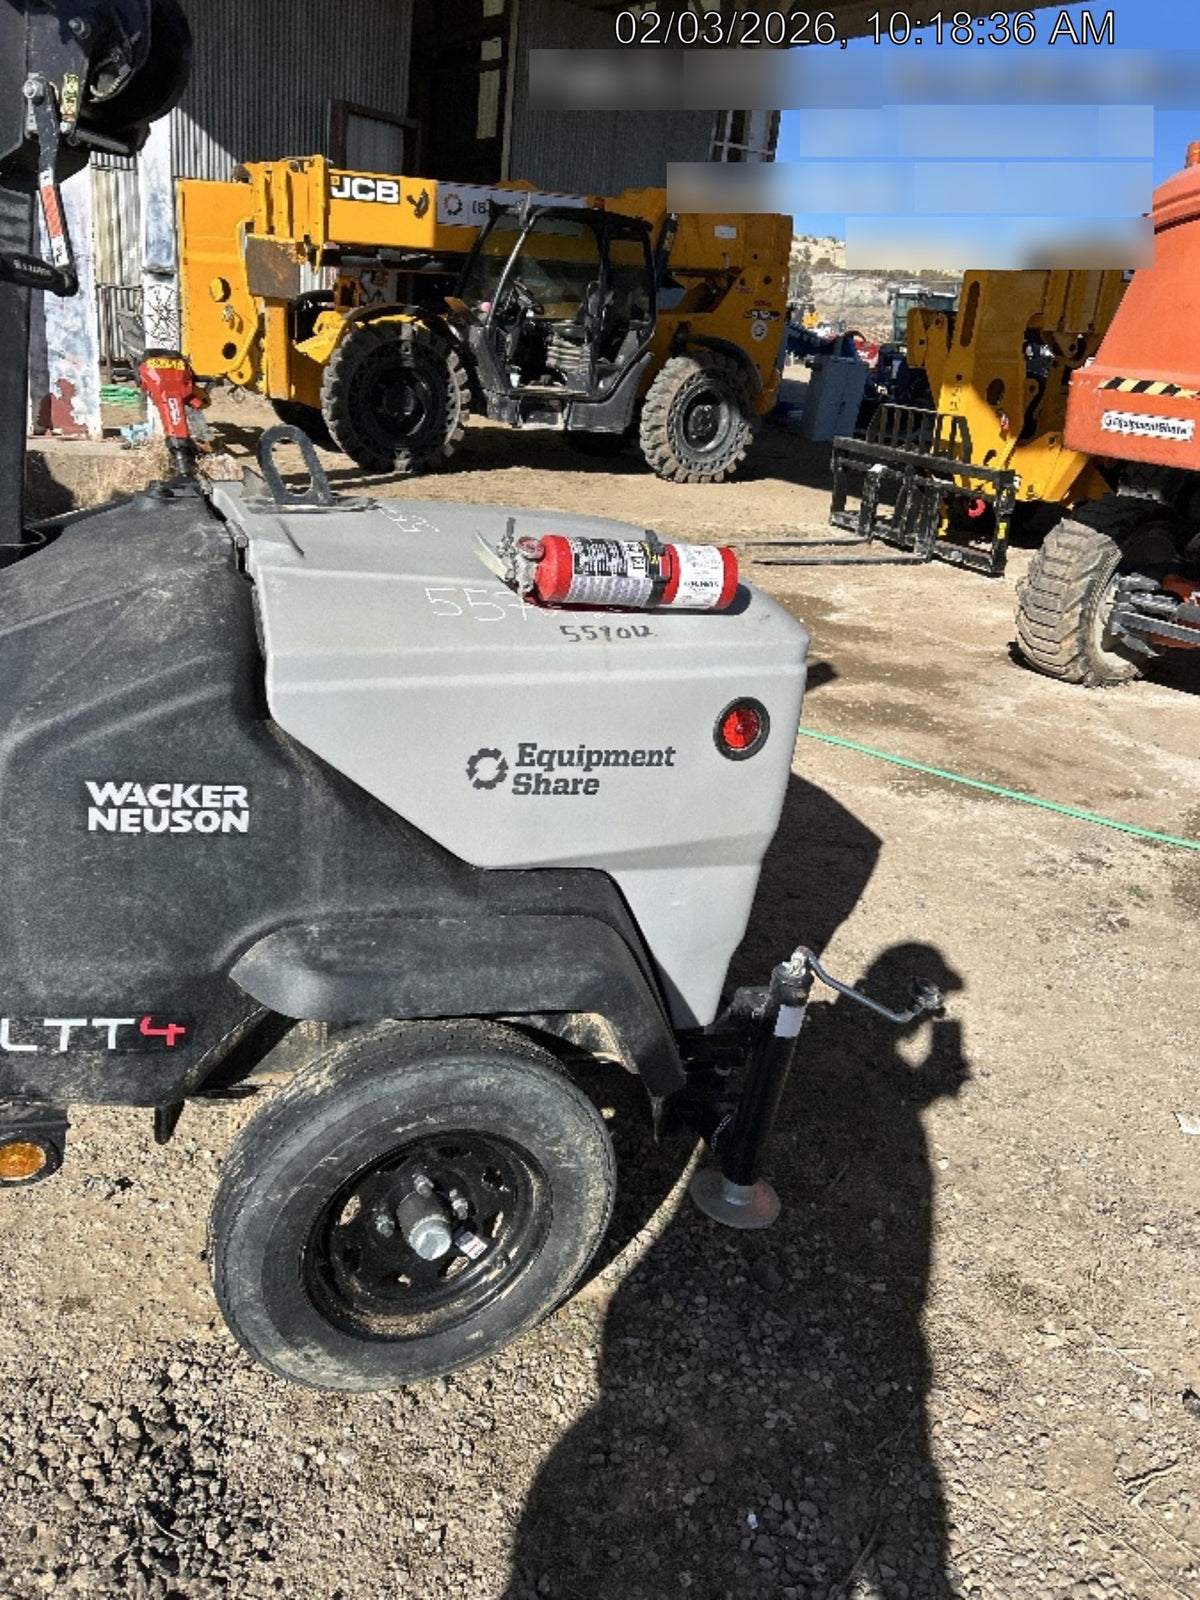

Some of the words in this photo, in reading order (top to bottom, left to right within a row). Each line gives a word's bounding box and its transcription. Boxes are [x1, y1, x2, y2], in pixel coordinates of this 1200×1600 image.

[331, 177, 399, 203] JCB
[515, 743, 676, 772] Equipment
[85, 781, 249, 808] WACKER
[512, 773, 599, 795] Share
[88, 807, 250, 833] NEUSON
